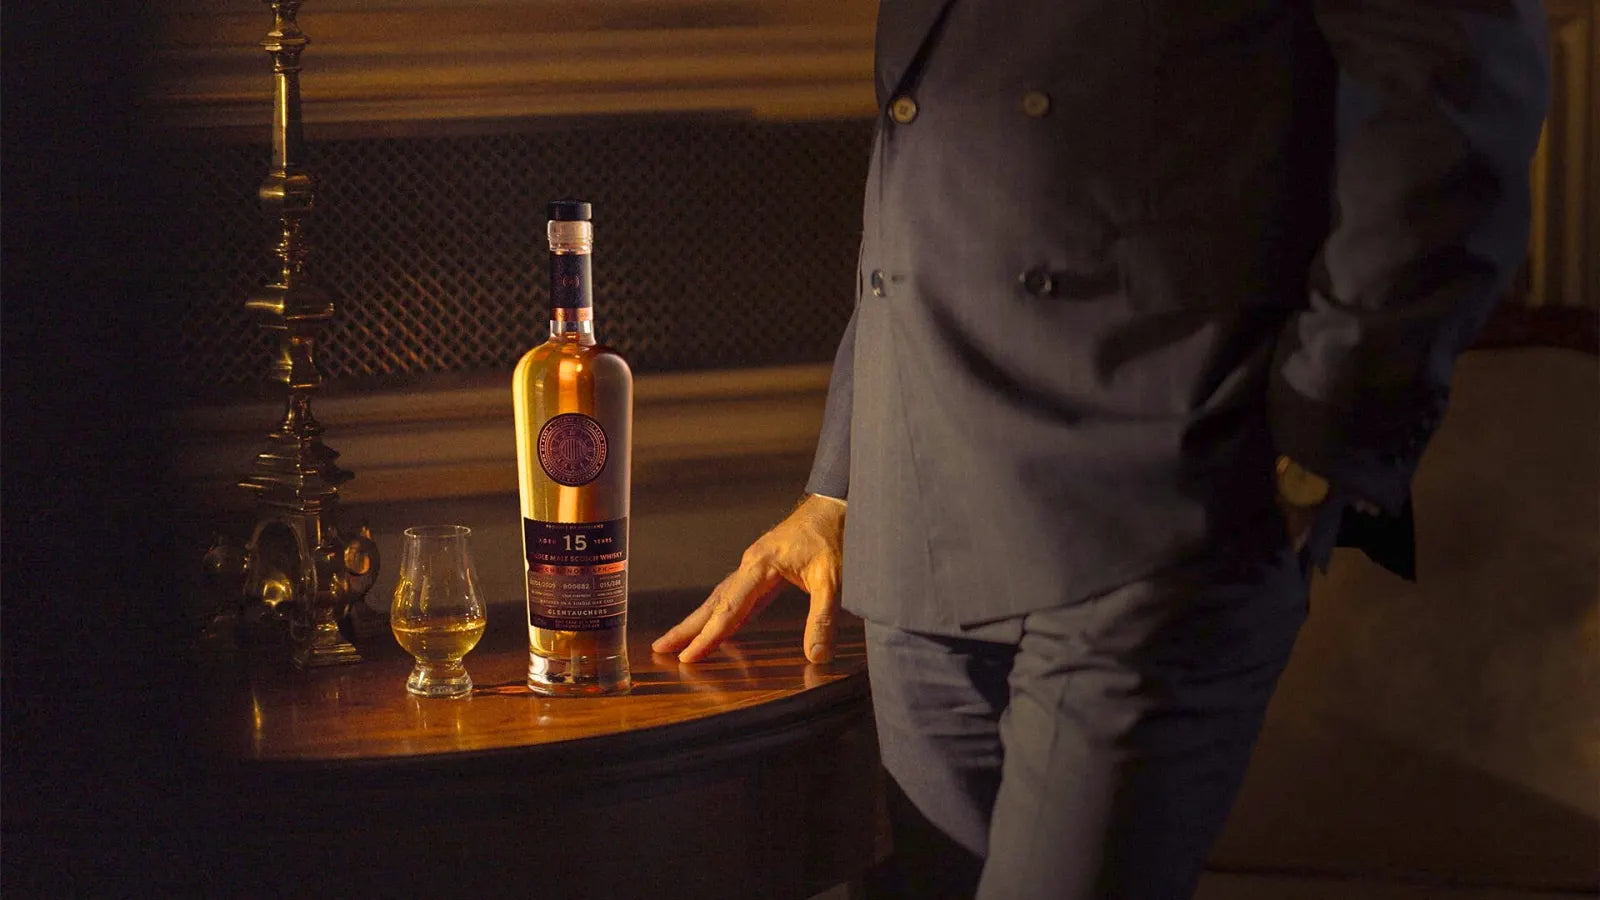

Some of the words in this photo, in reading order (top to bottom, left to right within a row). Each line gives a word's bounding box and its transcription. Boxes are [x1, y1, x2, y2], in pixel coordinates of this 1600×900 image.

[563, 534, 587, 551] 15
[599, 551, 623, 561] WHISKY
[547, 608, 608, 616] GLENTAUCHERS
